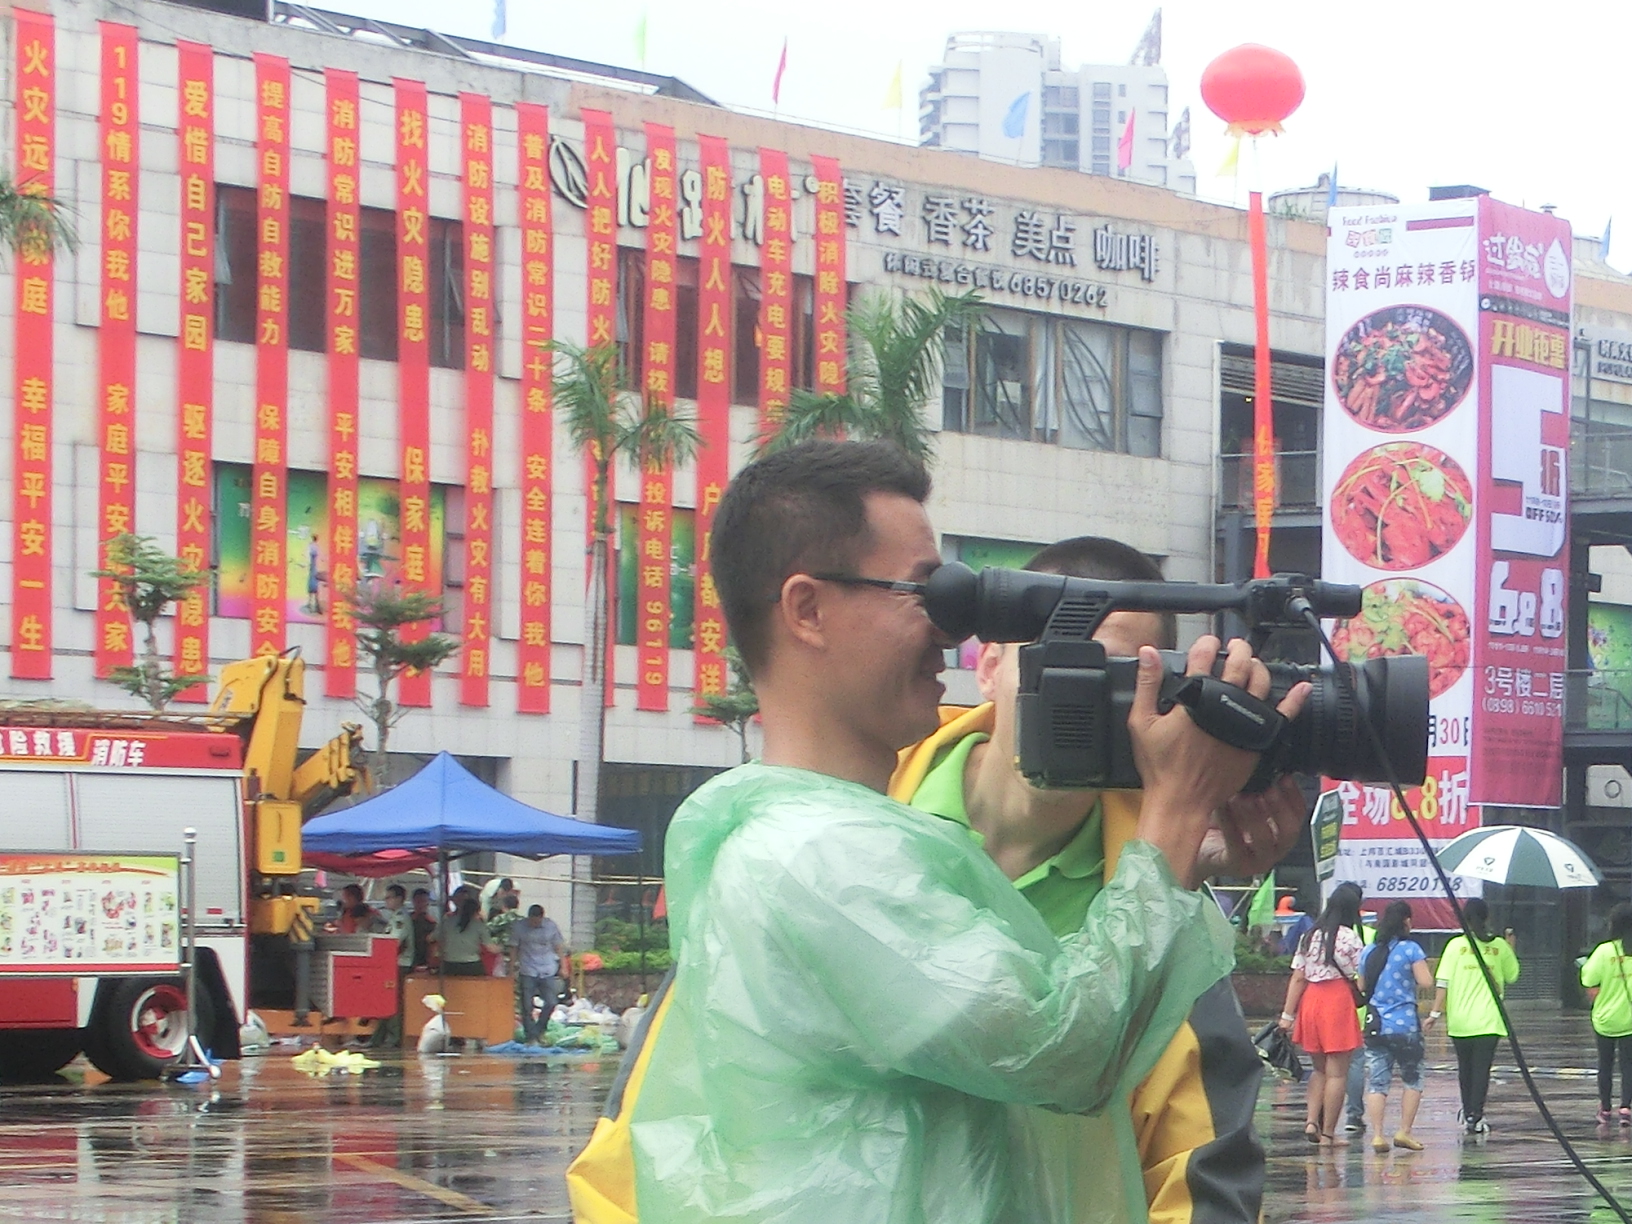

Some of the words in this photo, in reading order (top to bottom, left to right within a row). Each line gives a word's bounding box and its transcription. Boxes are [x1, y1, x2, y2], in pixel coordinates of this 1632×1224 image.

[21, 39, 50, 315] 火灾远家庭
[105, 45, 132, 321] 119情系你我他
[183, 79, 209, 352] 爱惜自己家园
[258, 79, 284, 346] 提高自防自救能力
[332, 98, 357, 355] 消防常识进万家
[400, 109, 426, 343] 找火灾隐患
[467, 123, 491, 373] 消防设施别乱动
[523, 133, 549, 413] 普及消防常识二十条
[649, 147, 673, 311] 发现火灾隐患
[703, 166, 728, 383] 防火人人想
[817, 181, 840, 400] 积极消除火灾隐
[921, 195, 994, 250] 香茶
[1012, 211, 1077, 266] 美点
[1094, 224, 1161, 281] 咖啡
[19, 377, 47, 652] 幸福平安一生
[466, 428, 490, 678] 扑救火灾有大用
[523, 452, 548, 688] 安全连着你我他
[0, 730, 77, 757] 险救援
